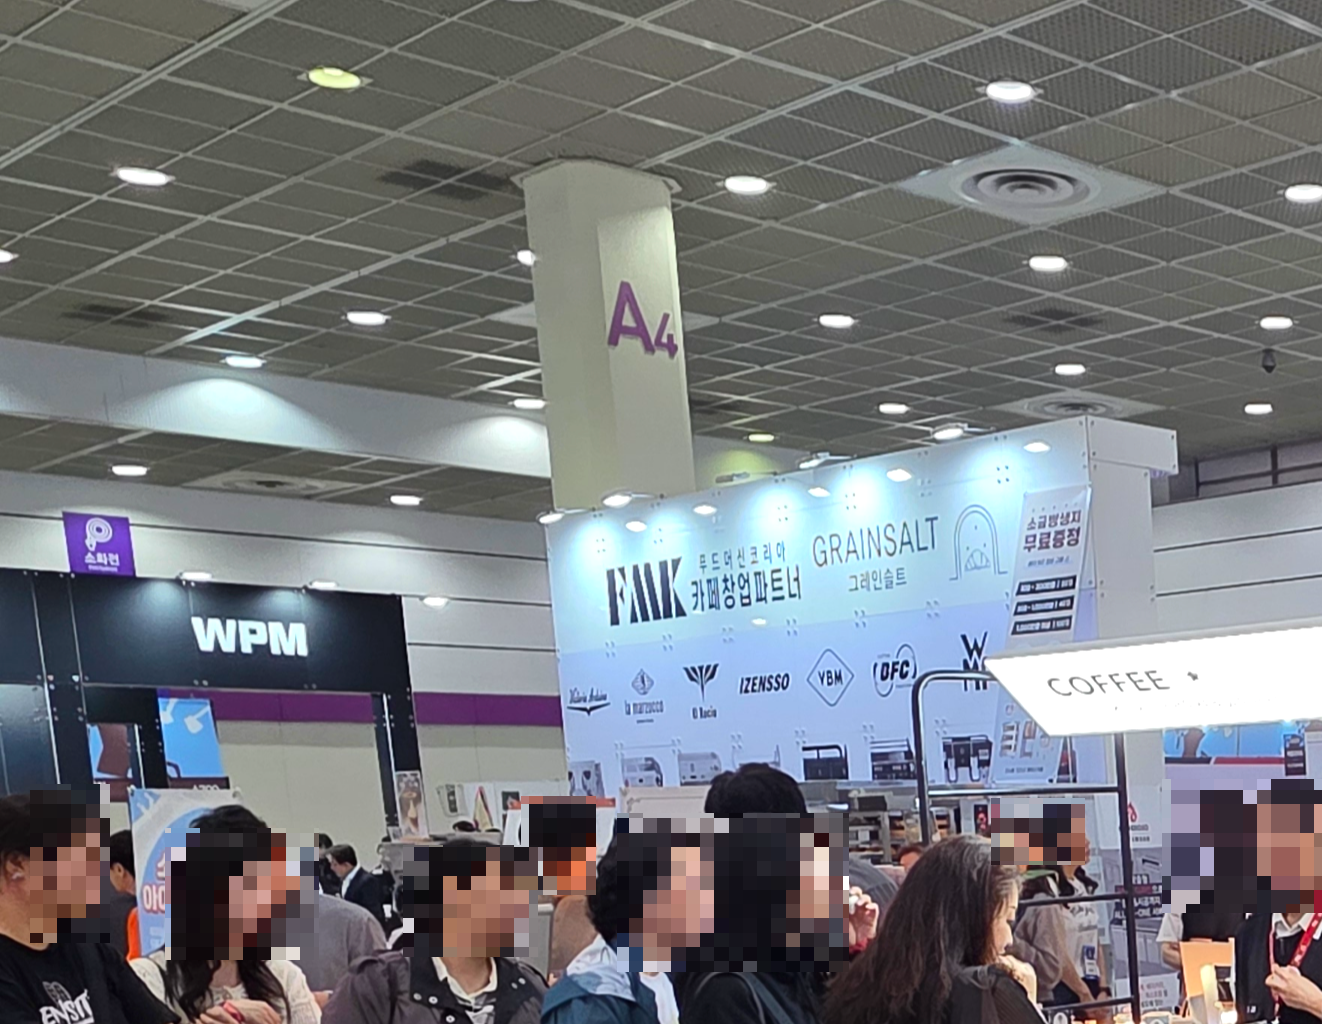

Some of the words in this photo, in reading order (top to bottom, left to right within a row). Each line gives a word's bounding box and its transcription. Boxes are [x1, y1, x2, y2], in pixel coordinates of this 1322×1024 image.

[607, 280, 678, 359] A4
[812, 516, 939, 568] GRAINSALT
[1023, 526, 1081, 552] 무료증정
[691, 564, 802, 612] 카페창업파트너
[191, 616, 308, 657] WPM
[739, 673, 790, 695] IZENSSO
[1047, 670, 1171, 697] COFFEE
